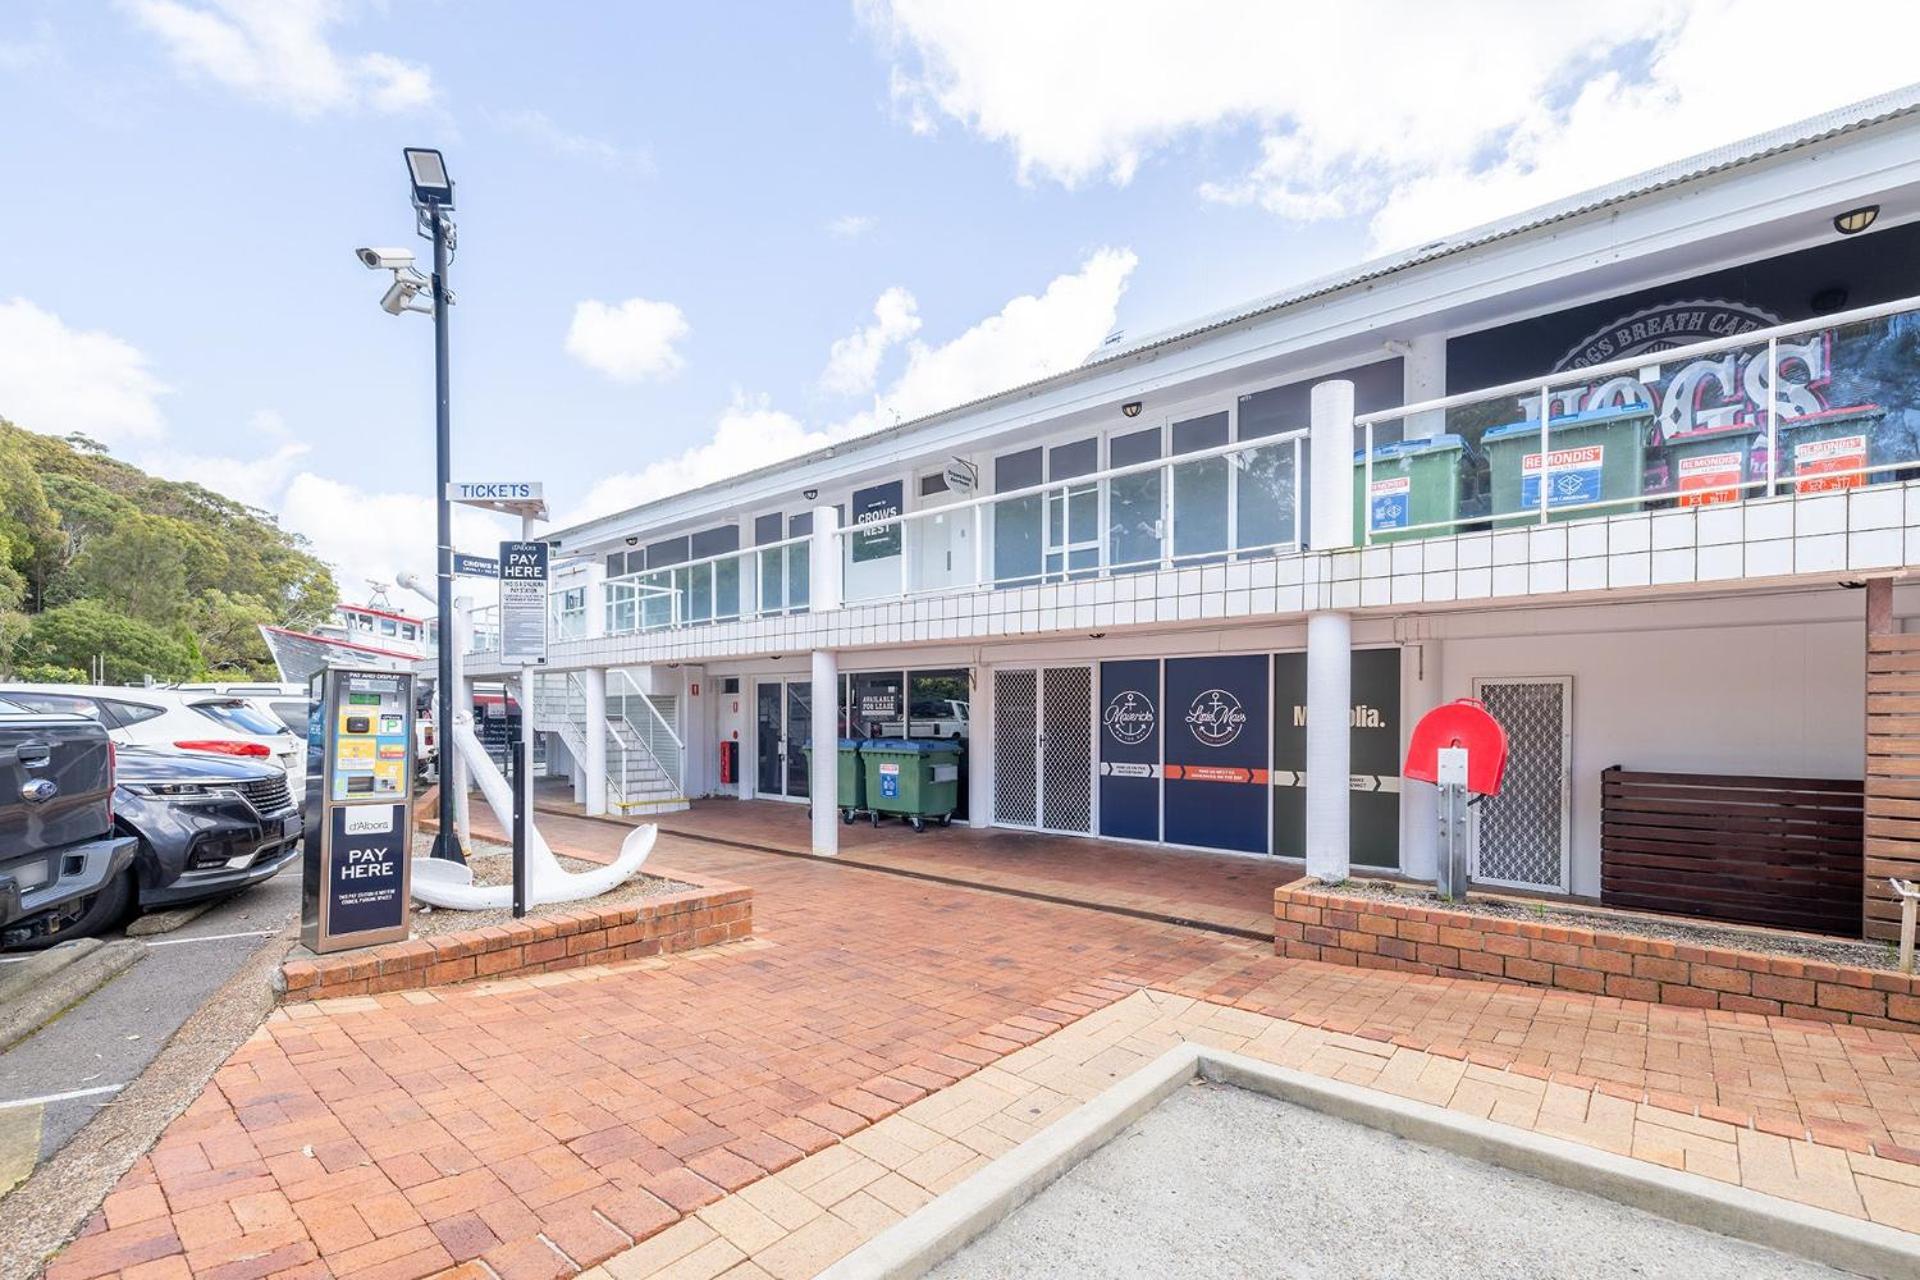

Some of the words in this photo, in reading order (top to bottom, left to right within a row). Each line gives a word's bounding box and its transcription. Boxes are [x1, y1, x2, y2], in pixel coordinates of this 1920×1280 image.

[1566, 338, 1614, 369] OGS
[1615, 311, 1707, 347] BREATH
[1709, 312, 1764, 336] CAF
[461, 484, 530, 498] TICKETS
[858, 506, 897, 523] CROWS
[510, 554, 538, 565] PAY
[505, 566, 543, 578] HERE
[349, 847, 388, 864] PAY
[341, 862, 394, 880] HERE
